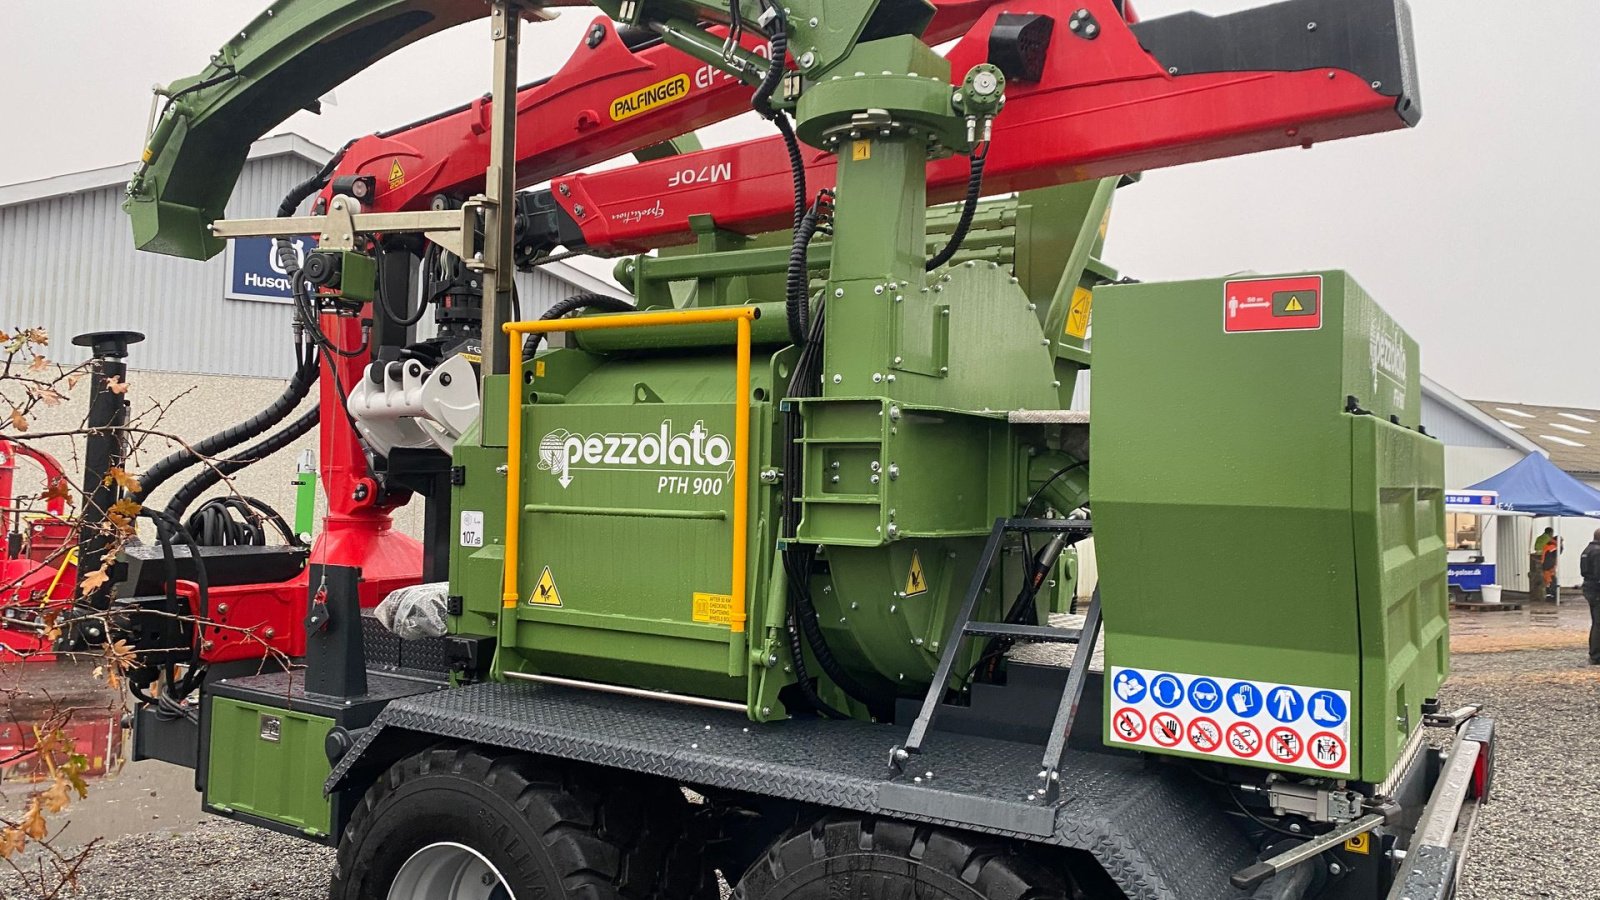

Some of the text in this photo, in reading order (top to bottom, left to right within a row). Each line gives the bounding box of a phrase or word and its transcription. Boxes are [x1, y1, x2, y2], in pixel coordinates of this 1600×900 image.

[614, 78, 685, 117] PALFINGER
[668, 162, 731, 187] M70F
[563, 419, 732, 489] pezzolato
[657, 476, 722, 496] PTH 900
[463, 531, 475, 544] 107
